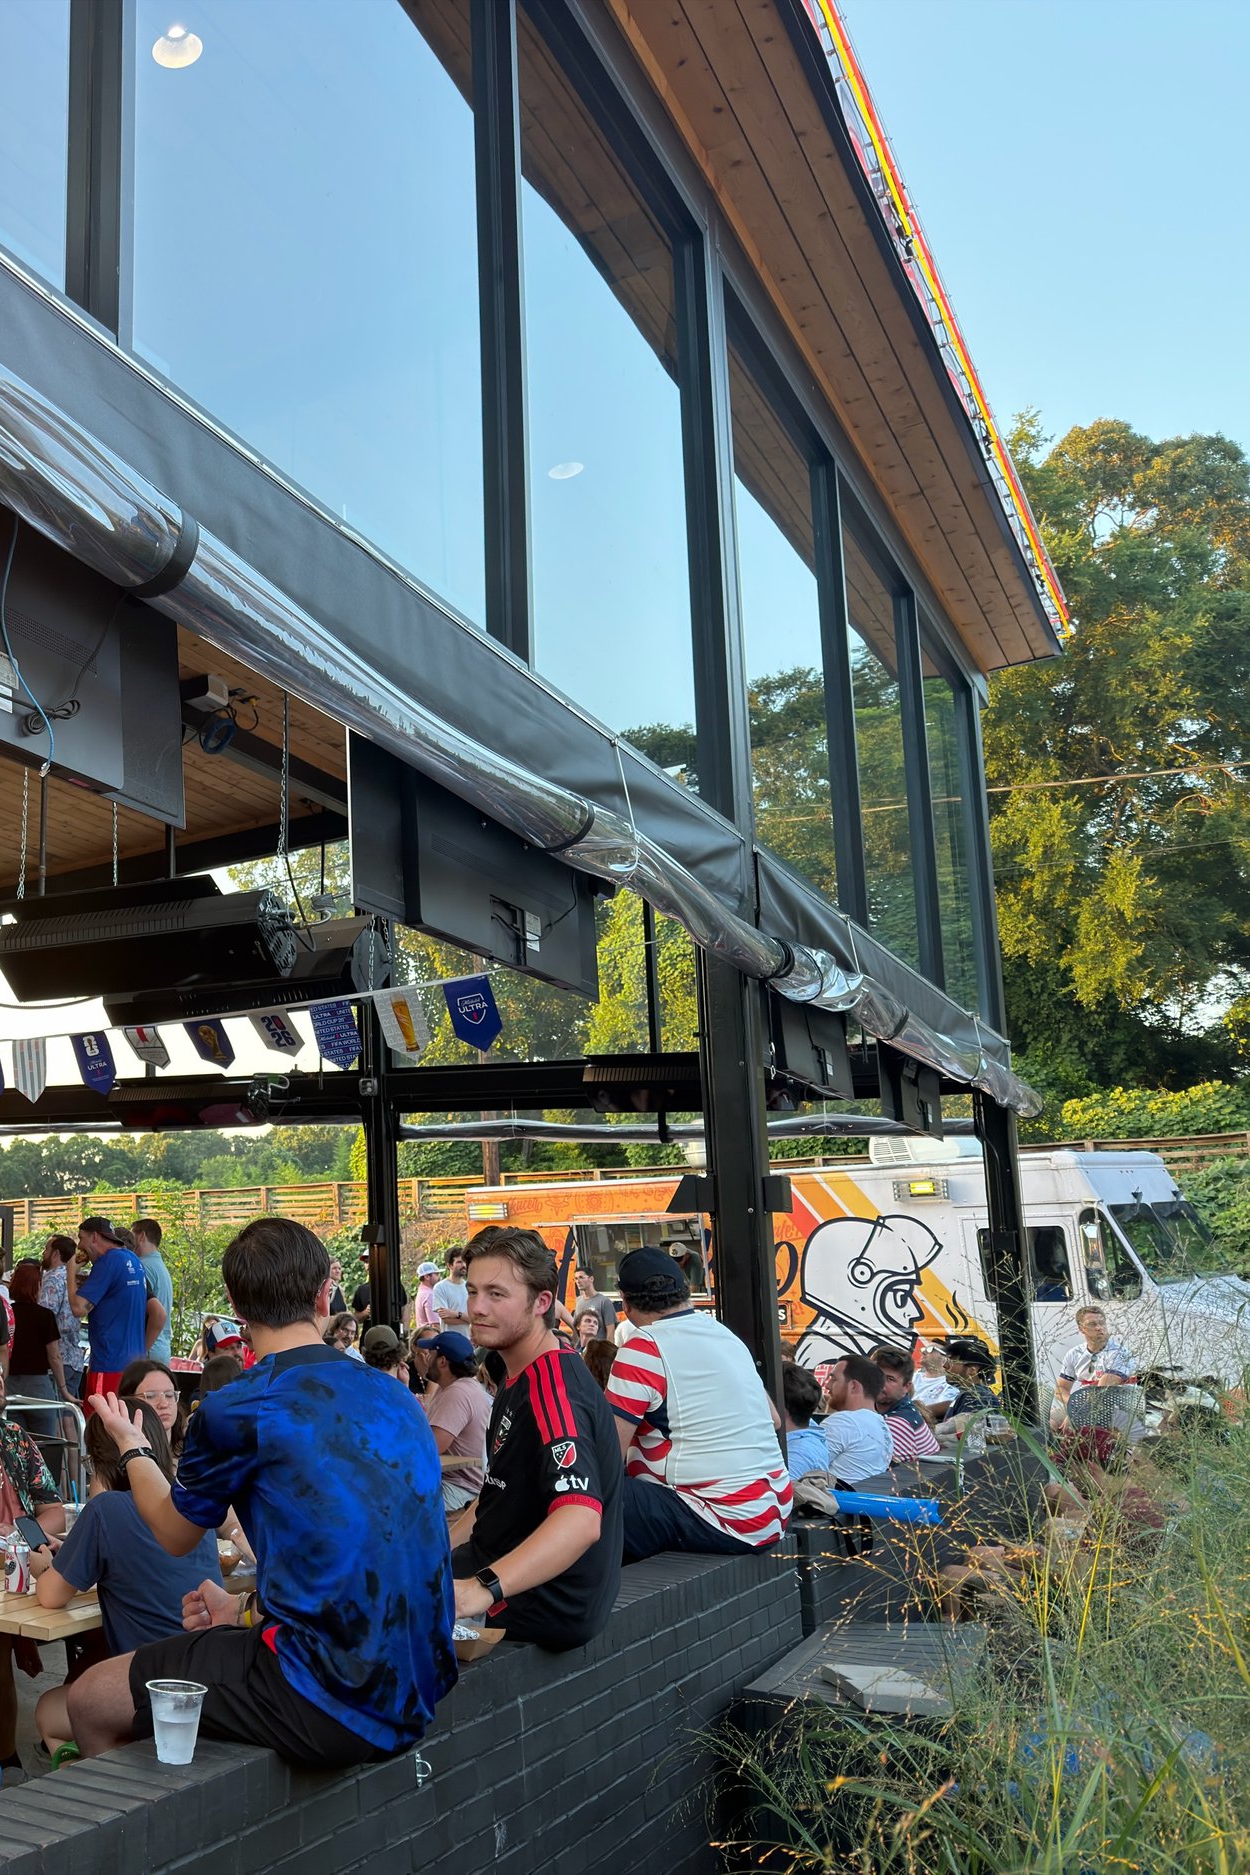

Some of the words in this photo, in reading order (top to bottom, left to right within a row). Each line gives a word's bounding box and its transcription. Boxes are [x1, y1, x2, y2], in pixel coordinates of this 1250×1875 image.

[458, 1002, 489, 1014] ULTRA
[312, 1012, 331, 1020] ULTRA
[271, 1030, 297, 1048] 26
[87, 1061, 108, 1071] ULTRA
[554, 1445, 567, 1453] MLS
[569, 1475, 589, 1491] tv
